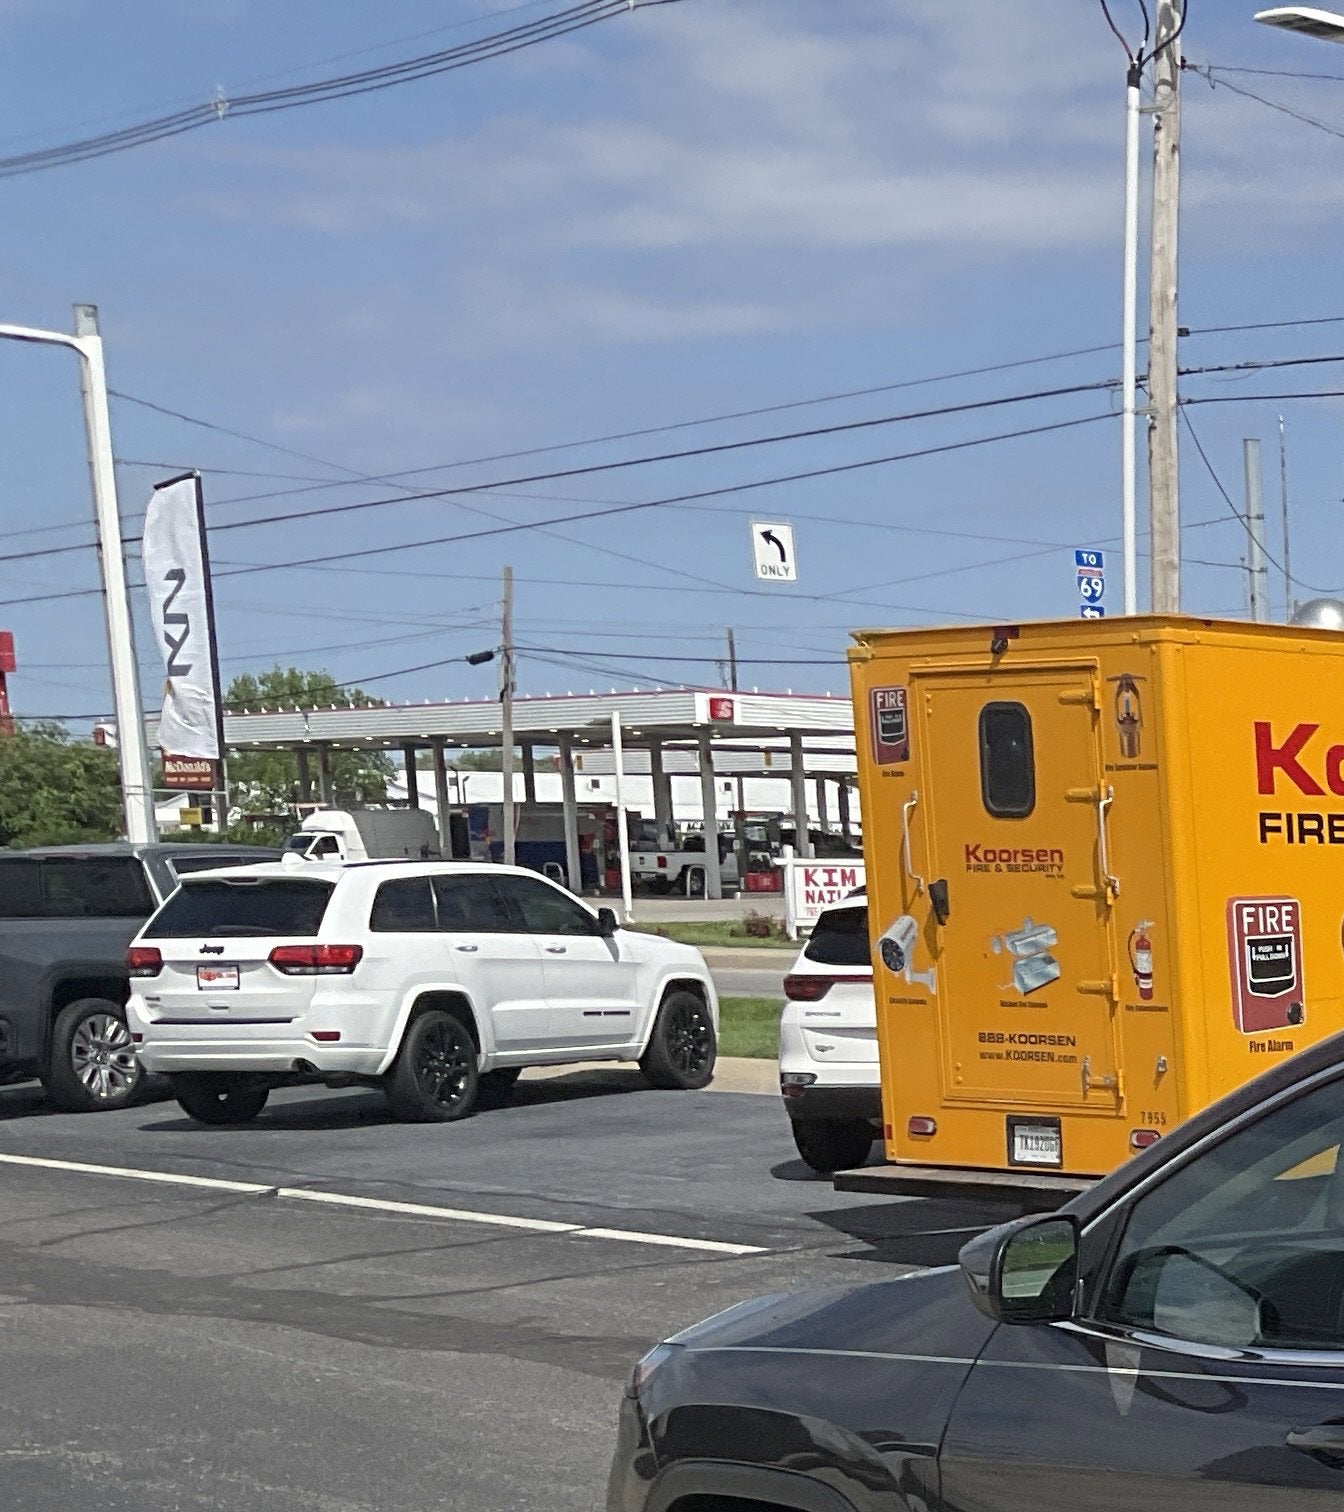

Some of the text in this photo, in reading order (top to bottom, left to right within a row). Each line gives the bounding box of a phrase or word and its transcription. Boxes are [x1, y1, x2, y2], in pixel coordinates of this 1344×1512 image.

[1082, 553, 1097, 565] TO
[760, 564, 790, 577] ONLY
[1081, 577, 1103, 598] 69
[876, 690, 905, 708] FIRE
[964, 843, 1064, 864] Koorsen
[965, 863, 992, 873] FIRE
[1006, 863, 1064, 873] SECURITY
[804, 868, 857, 887] KIM
[1242, 905, 1294, 934] FIRE
[978, 1032, 1076, 1047] 888-KOORSEN
[1250, 1039, 1294, 1053] Fire Alarm
[979, 1050, 1078, 1063] www.KOORSEN.com
